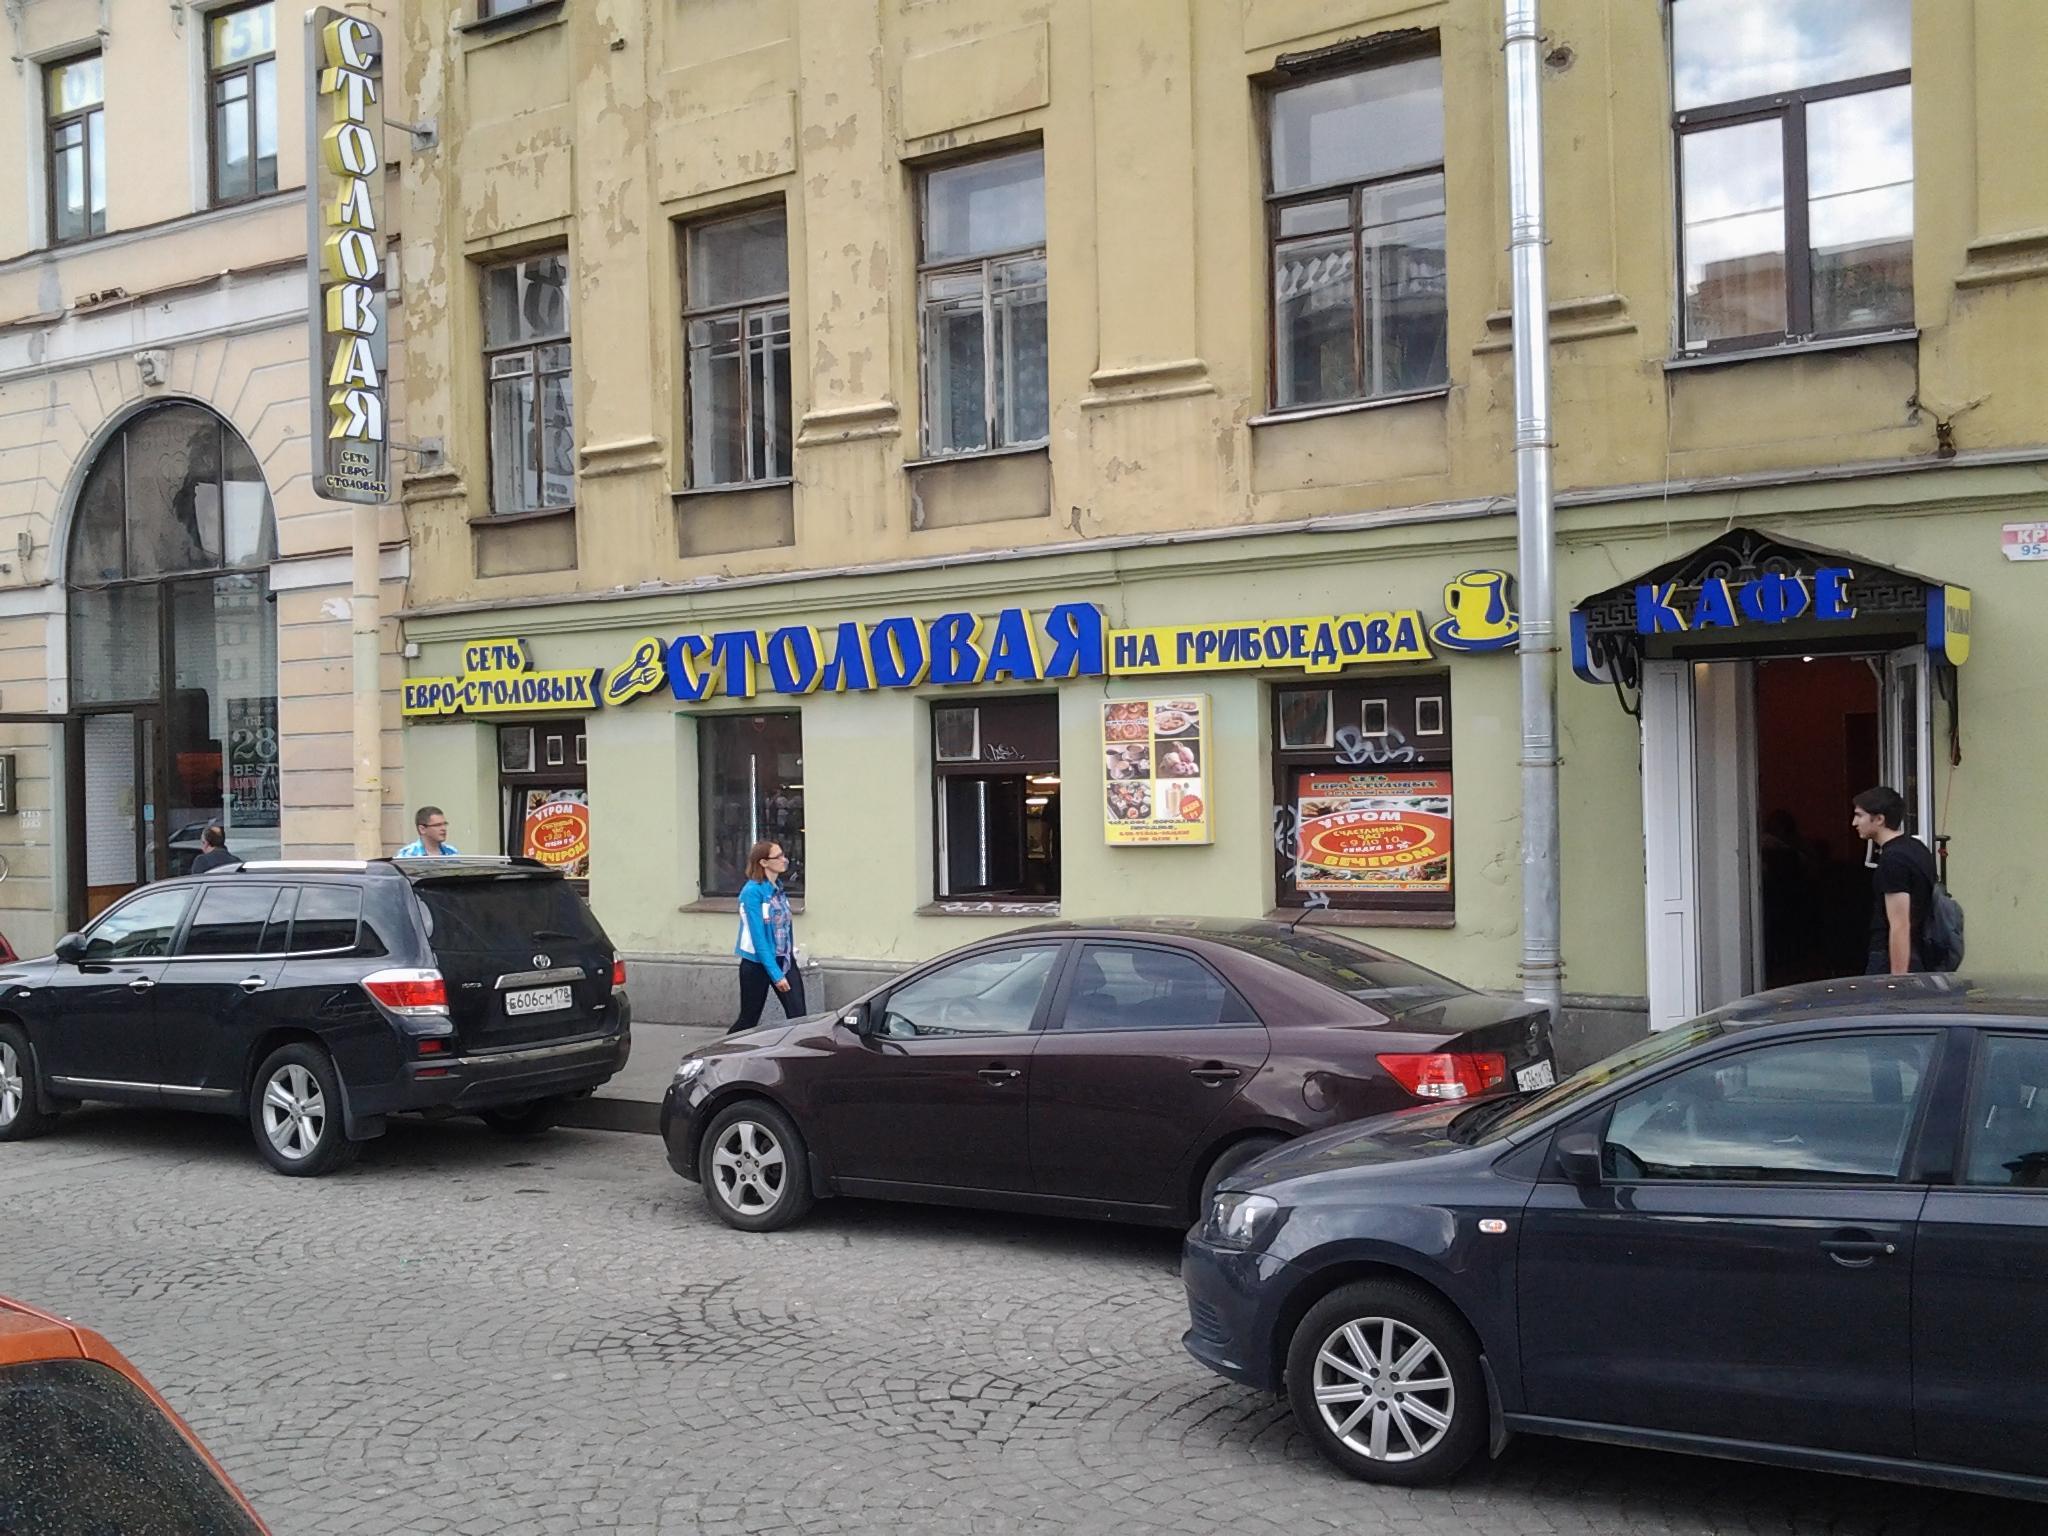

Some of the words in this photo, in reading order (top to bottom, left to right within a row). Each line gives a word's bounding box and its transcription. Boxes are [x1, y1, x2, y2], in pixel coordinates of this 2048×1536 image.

[318, 16, 384, 442] СТОЛОВАЯ
[341, 450, 370, 465] СЕТЬ
[325, 475, 387, 494] СТОЛОВЫХ
[1635, 567, 1858, 634] КАФЕ
[666, 602, 1107, 700] СТОЛОВАЯ
[1115, 634, 1160, 668] НА
[1176, 617, 1420, 665] ГРИБОЕДОВА
[466, 644, 520, 671] СЕТЬ
[405, 674, 587, 709] ЕВРО-СТОЛОВЫХ
[232, 727, 277, 761] 28
[233, 763, 278, 777] BEST
[535, 804, 573, 821] УТРОМ
[1318, 811, 1401, 829] УТРОМ
[535, 841, 586, 862] ВЕЧЕРОМ
[1324, 846, 1436, 867] ВЕЧЕРОМ
